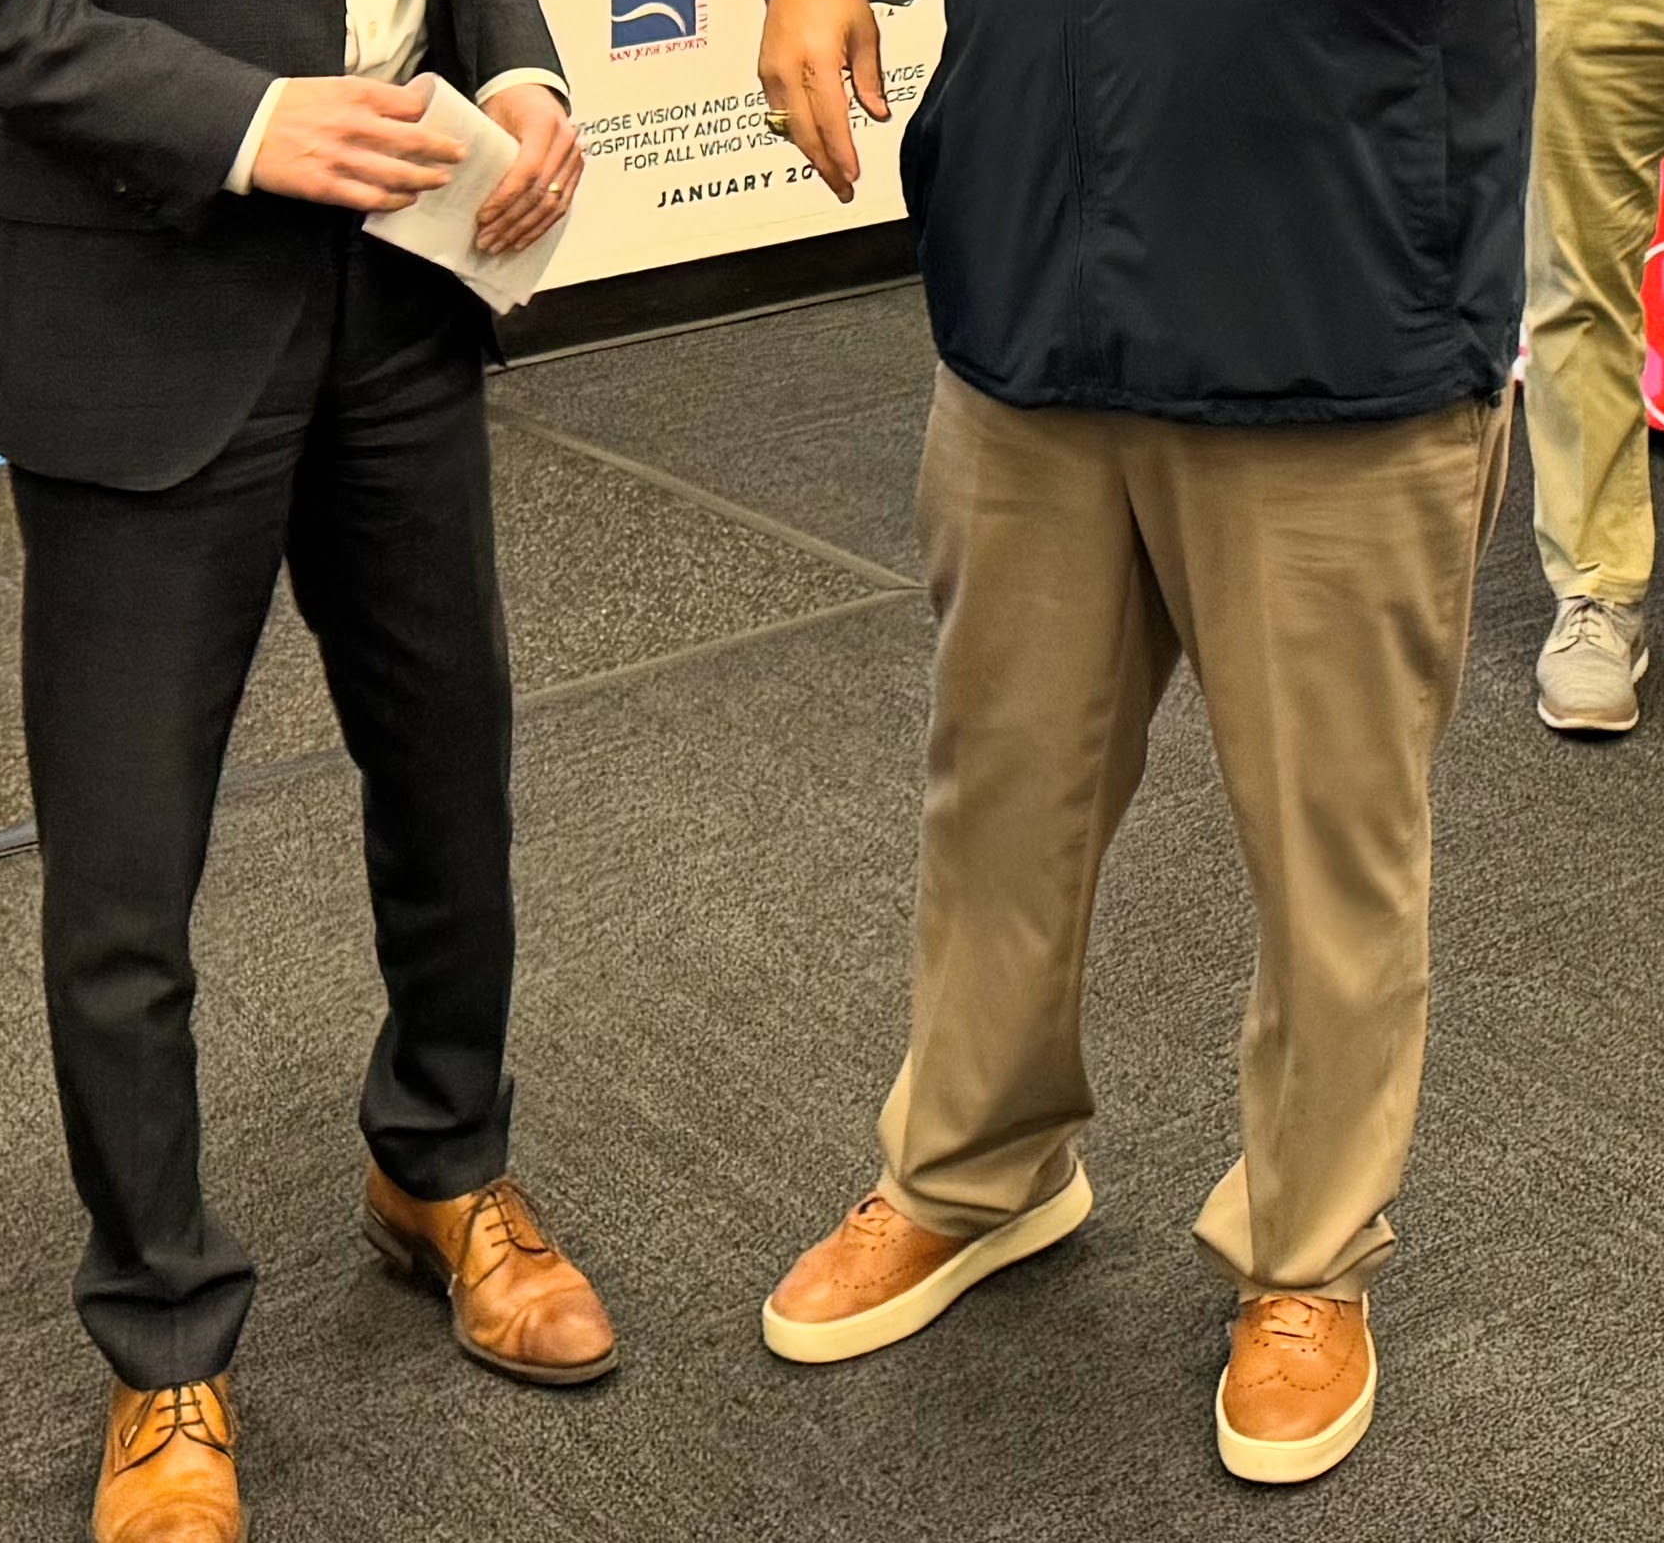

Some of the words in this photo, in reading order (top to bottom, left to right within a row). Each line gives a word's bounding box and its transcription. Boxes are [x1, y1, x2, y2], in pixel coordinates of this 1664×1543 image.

[636, 102, 697, 127] VISION
[702, 95, 740, 116] AND
[694, 117, 732, 139] AND
[623, 151, 660, 172] FOR
[664, 145, 695, 165] ALL
[700, 136, 743, 158] WHO
[747, 130, 778, 149] VIS
[657, 170, 774, 208] JANUARY
[785, 163, 819, 185] 20
